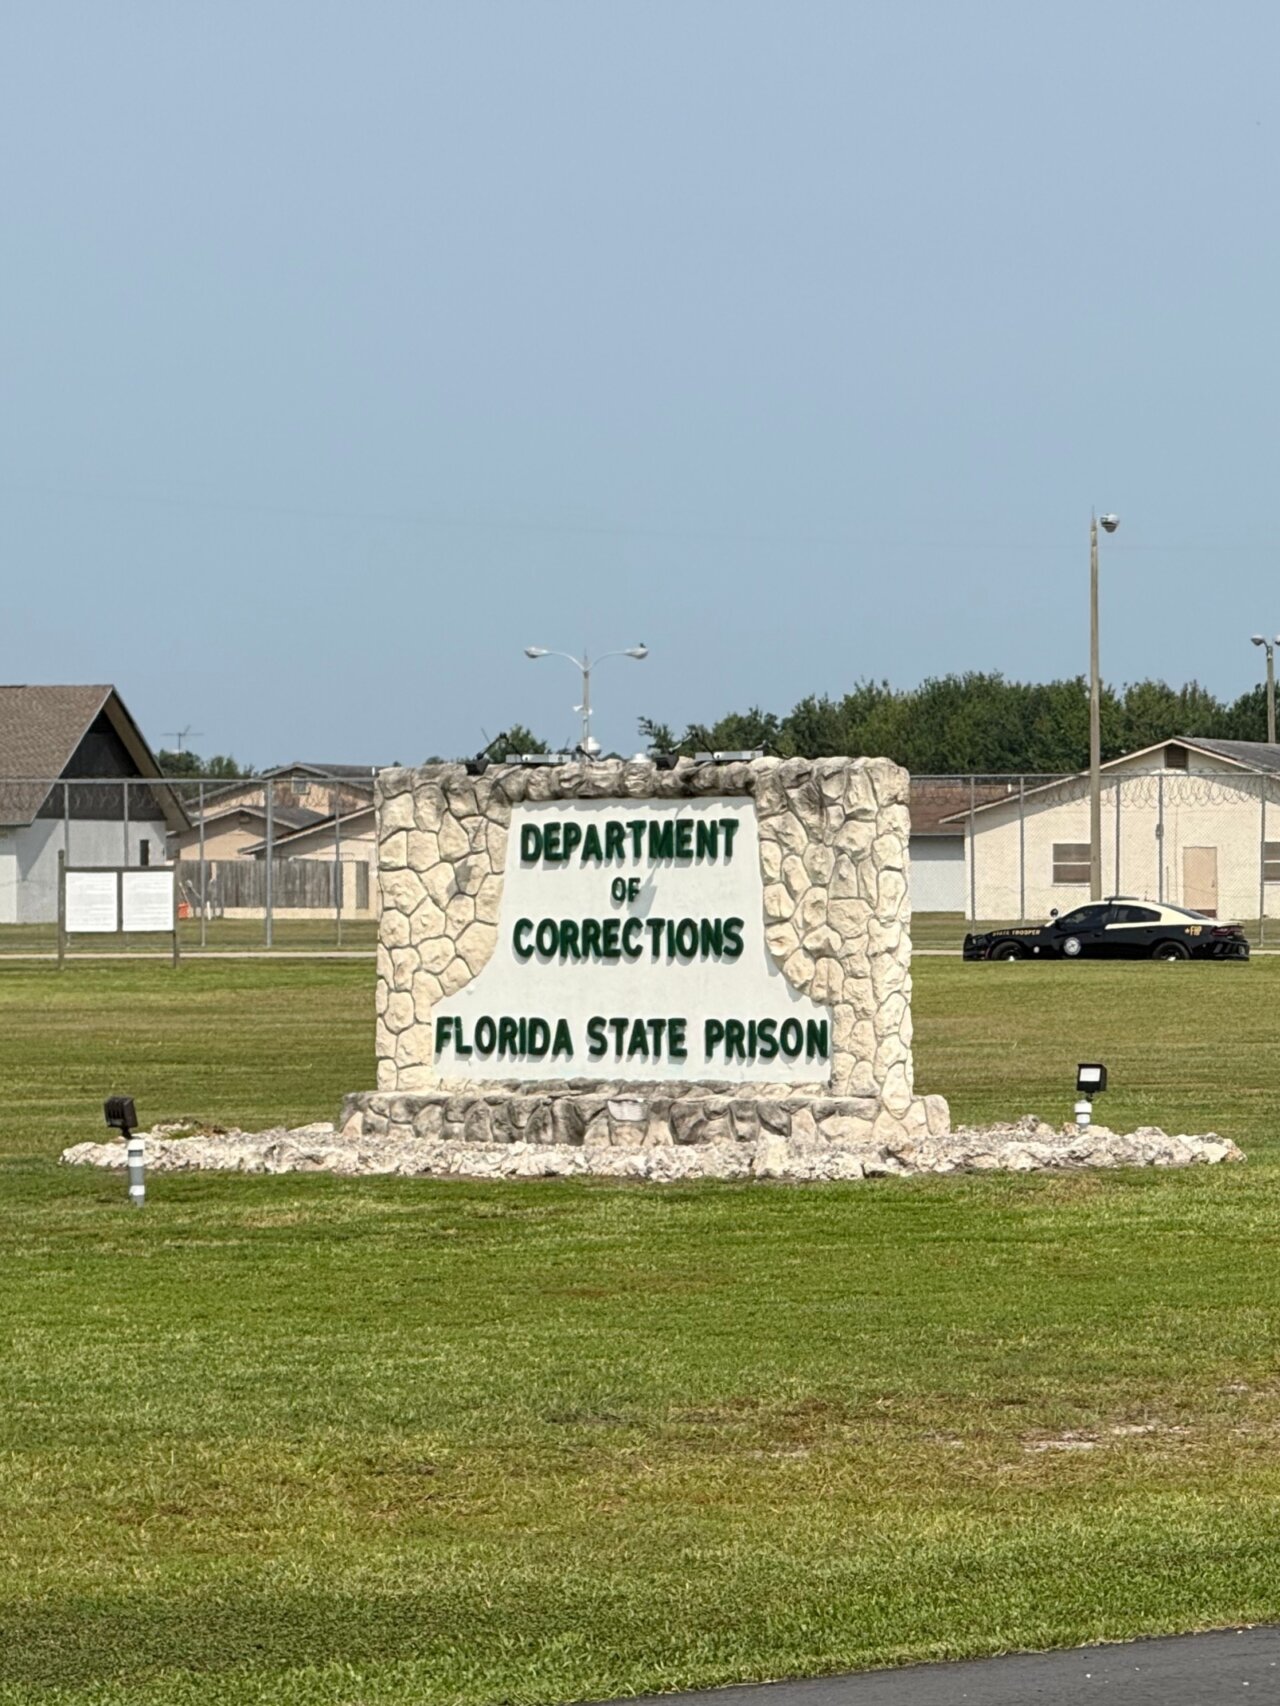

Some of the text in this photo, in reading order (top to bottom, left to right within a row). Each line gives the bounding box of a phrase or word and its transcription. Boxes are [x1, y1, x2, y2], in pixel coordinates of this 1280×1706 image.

[521, 819, 738, 863] DEPARTMENT
[612, 877, 640, 903] OF
[514, 917, 743, 959] CORRECTIONS
[436, 1016, 828, 1058] FLORIDA STATE PRISON
